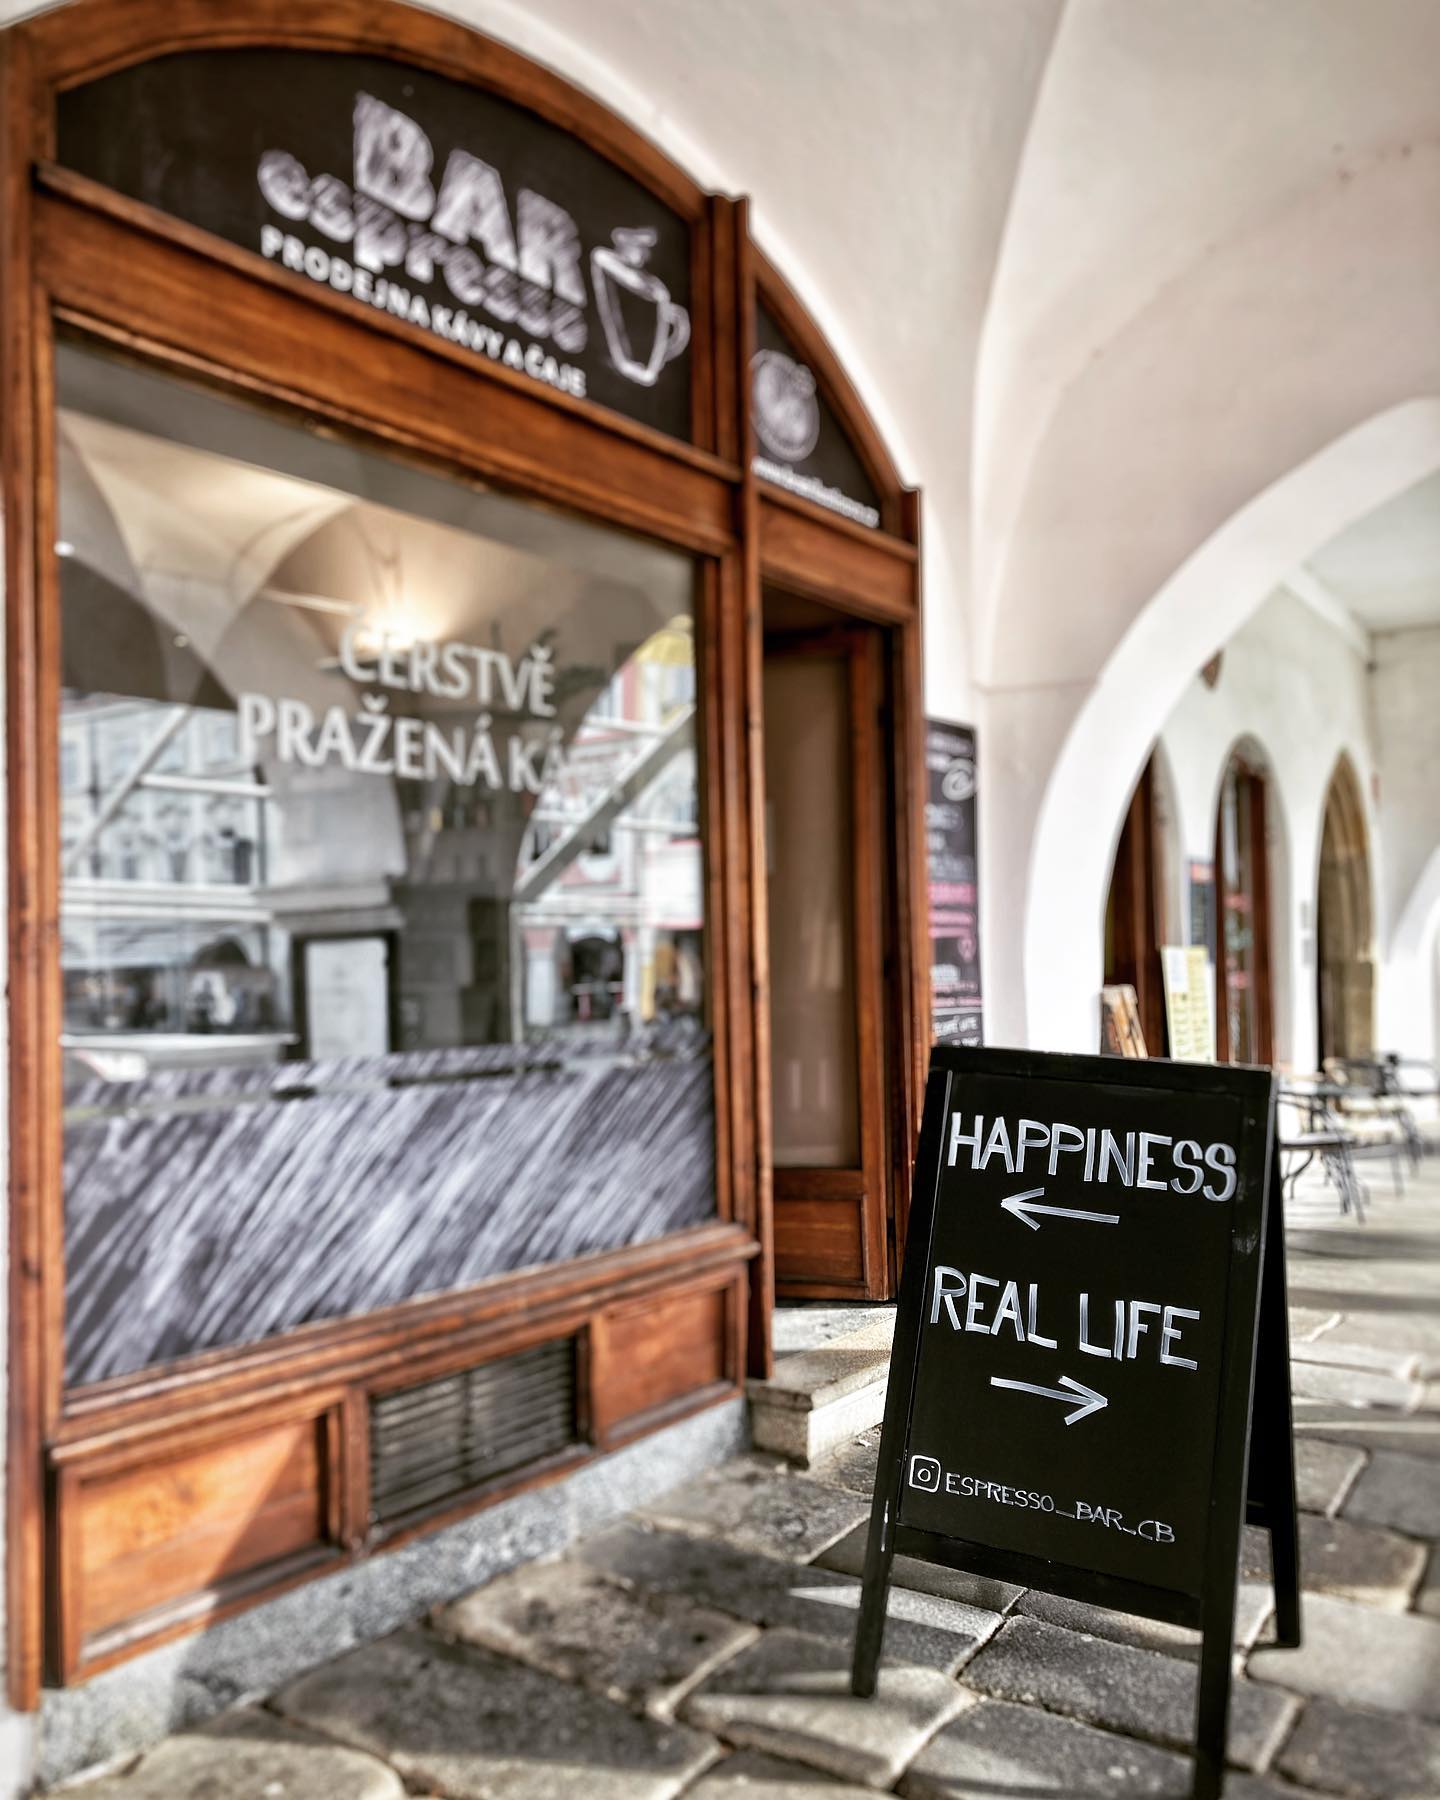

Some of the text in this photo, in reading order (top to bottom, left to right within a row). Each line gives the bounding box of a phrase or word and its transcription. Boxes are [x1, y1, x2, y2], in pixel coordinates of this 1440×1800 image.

[353, 90, 587, 307] BAR
[260, 223, 431, 329] PRODEJNA
[502, 338, 525, 371] A
[238, 693, 504, 792] PRAŽENÁ
[947, 1111, 1238, 1203] HAPPINESS
[930, 1265, 1200, 1371] REAL LIFE
[944, 1472, 1176, 1544] ESPRESSO_BAR_CB
